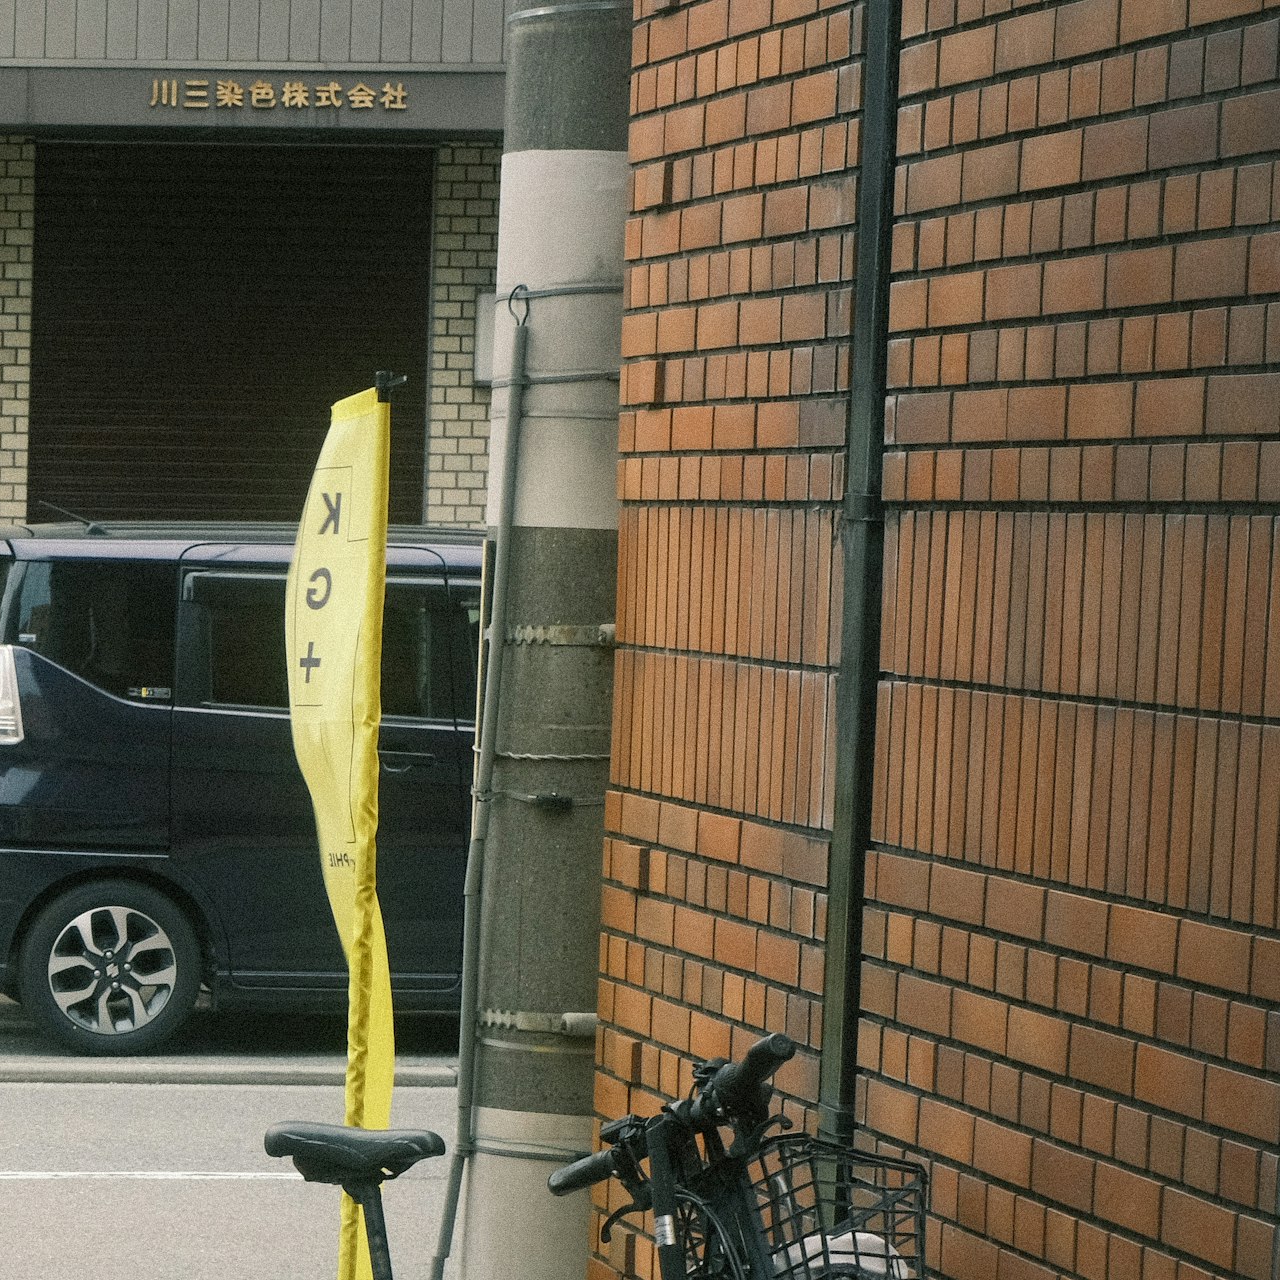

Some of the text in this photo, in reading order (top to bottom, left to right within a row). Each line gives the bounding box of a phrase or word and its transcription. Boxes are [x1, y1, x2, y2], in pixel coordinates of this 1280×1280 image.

[150, 79, 408, 109] 川三染色株式会社
